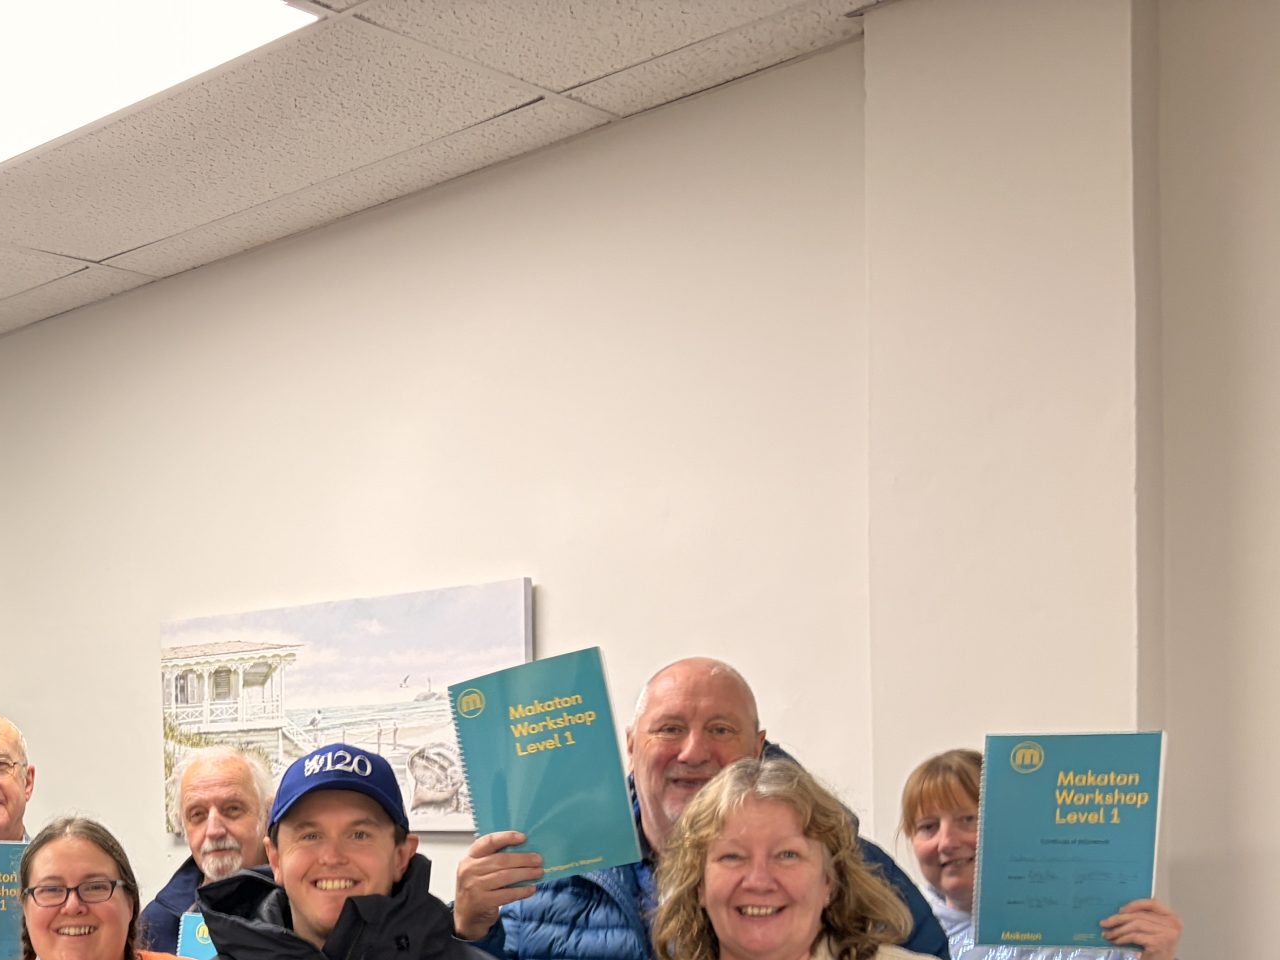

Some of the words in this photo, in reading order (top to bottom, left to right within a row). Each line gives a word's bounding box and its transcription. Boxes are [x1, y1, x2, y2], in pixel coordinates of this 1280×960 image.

[508, 694, 584, 722] Makaton
[510, 708, 597, 740] Workshop
[514, 734, 562, 757] Level
[564, 731, 576, 746] 1
[1057, 770, 1140, 786] Makaton
[1055, 788, 1149, 810] Workshop
[1055, 808, 1105, 824] Level
[1111, 807, 1120, 824] 1
[0, 900, 8, 912] 1
